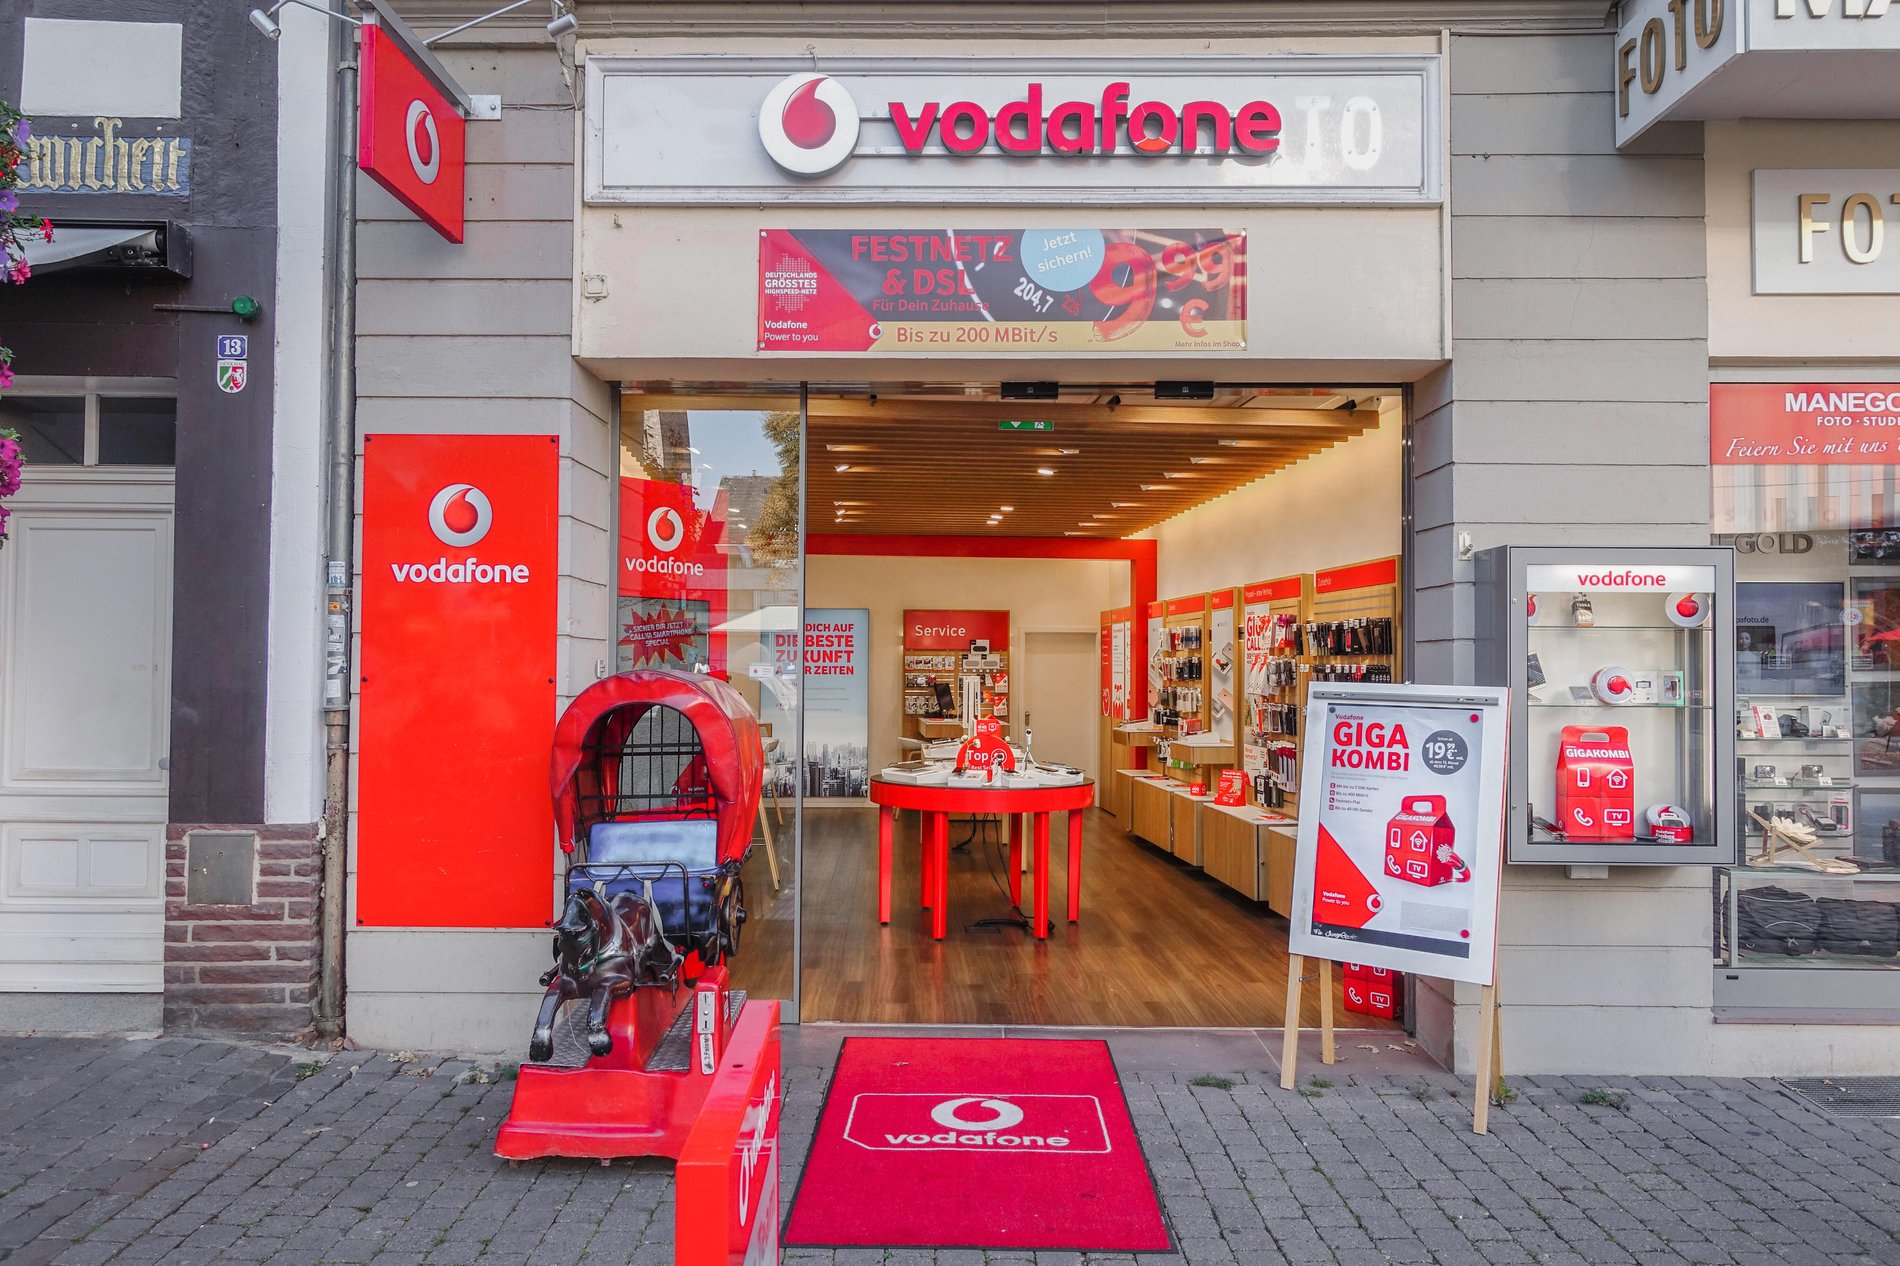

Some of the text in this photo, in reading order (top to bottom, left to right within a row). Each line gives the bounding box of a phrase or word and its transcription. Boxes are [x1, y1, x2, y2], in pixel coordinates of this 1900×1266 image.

[1619, 0, 1724, 118] FOTO
[889, 81, 1283, 158] vodafone
[1042, 231, 1078, 252] Jetzt
[851, 234, 1014, 263] FESTNETZ
[1037, 248, 1094, 274] sichern!
[765, 271, 818, 279] DEUTSCHLANDS
[765, 277, 817, 288] GRÖSSTES
[882, 268, 976, 296] & DSL
[1013, 276, 1055, 314] 204,7
[872, 299, 990, 312] Für Dein Zuhause
[764, 320, 808, 329] Vodafone
[764, 332, 819, 342] Power to you
[896, 325, 1058, 344] Bis zu 200 MBit/s
[223, 339, 242, 355] 13
[1174, 340, 1193, 348] Mehr
[1194, 340, 1212, 348] Infos
[1222, 340, 1242, 350] Shop
[1817, 416, 1852, 426] FOTO
[1725, 437, 1783, 458] Feiern
[1786, 436, 1819, 456] Sie
[1823, 437, 1855, 454] mit
[1859, 441, 1888, 454] uns
[391, 557, 530, 583] vodafone
[625, 555, 704, 576] vodafone
[1577, 570, 1667, 586] vodafone
[666, 621, 683, 629] JETZT
[805, 623, 831, 633] DICH
[832, 623, 855, 633] AUF
[915, 625, 966, 637] Service
[645, 639, 669, 647] SPECIAL
[804, 634, 855, 648] BESTE
[814, 666, 855, 675] ZEITEN
[1335, 713, 1364, 721] Vodafone
[1333, 721, 1410, 749] GIGA
[967, 750, 989, 763] Top
[1425, 742, 1446, 759] 19
[1565, 748, 1630, 759] GIGAKOMBI
[1331, 748, 1410, 772] KOMBI
[1395, 814, 1438, 823] GIGAKOMBI
[1412, 864, 1422, 872] TV
[1322, 890, 1346, 899] Vodafone
[885, 1131, 1071, 1147] vodafone
